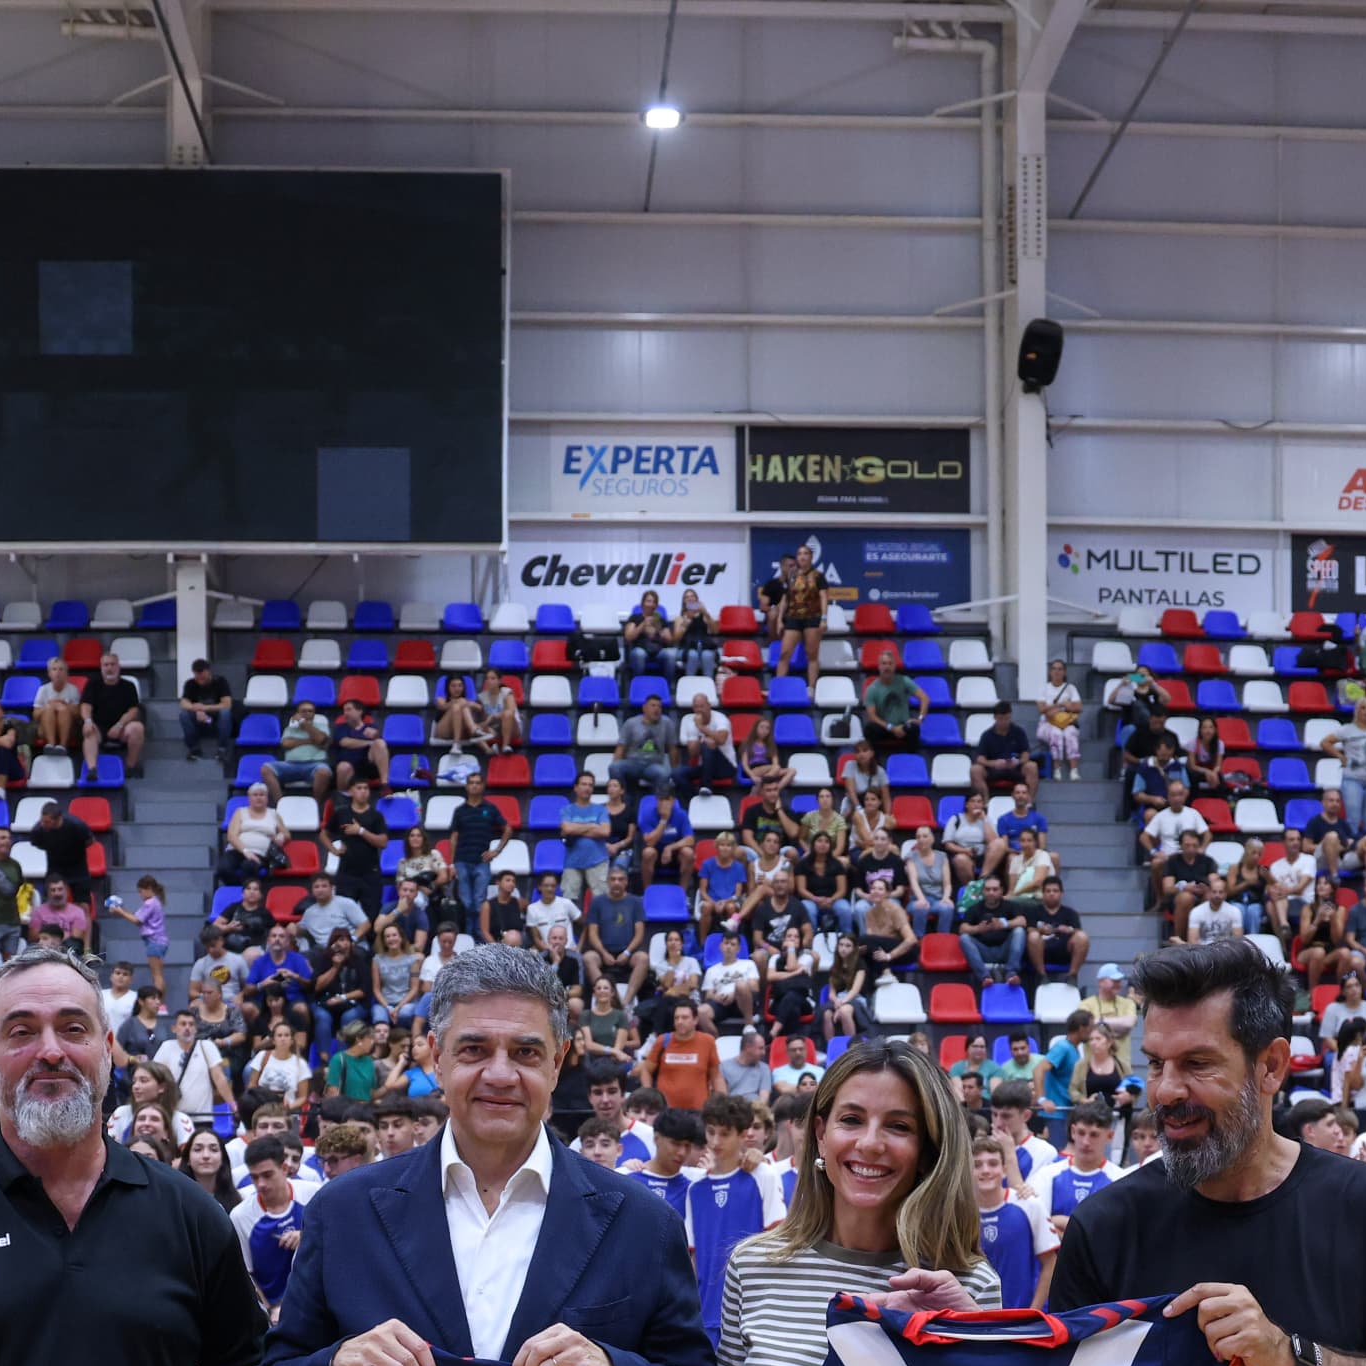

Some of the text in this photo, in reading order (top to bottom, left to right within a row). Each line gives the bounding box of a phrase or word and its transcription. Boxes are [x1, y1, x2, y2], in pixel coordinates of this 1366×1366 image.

[562, 445, 720, 491] EXPERTA
[749, 454, 963, 484] HAKEN GOLD
[592, 478, 689, 497] SEGUROS
[520, 552, 728, 588] Chevallier
[1086, 548, 1262, 576] MULTILED
[1306, 559, 1340, 580] SPEED
[1098, 587, 1226, 607] PANTALLAS
